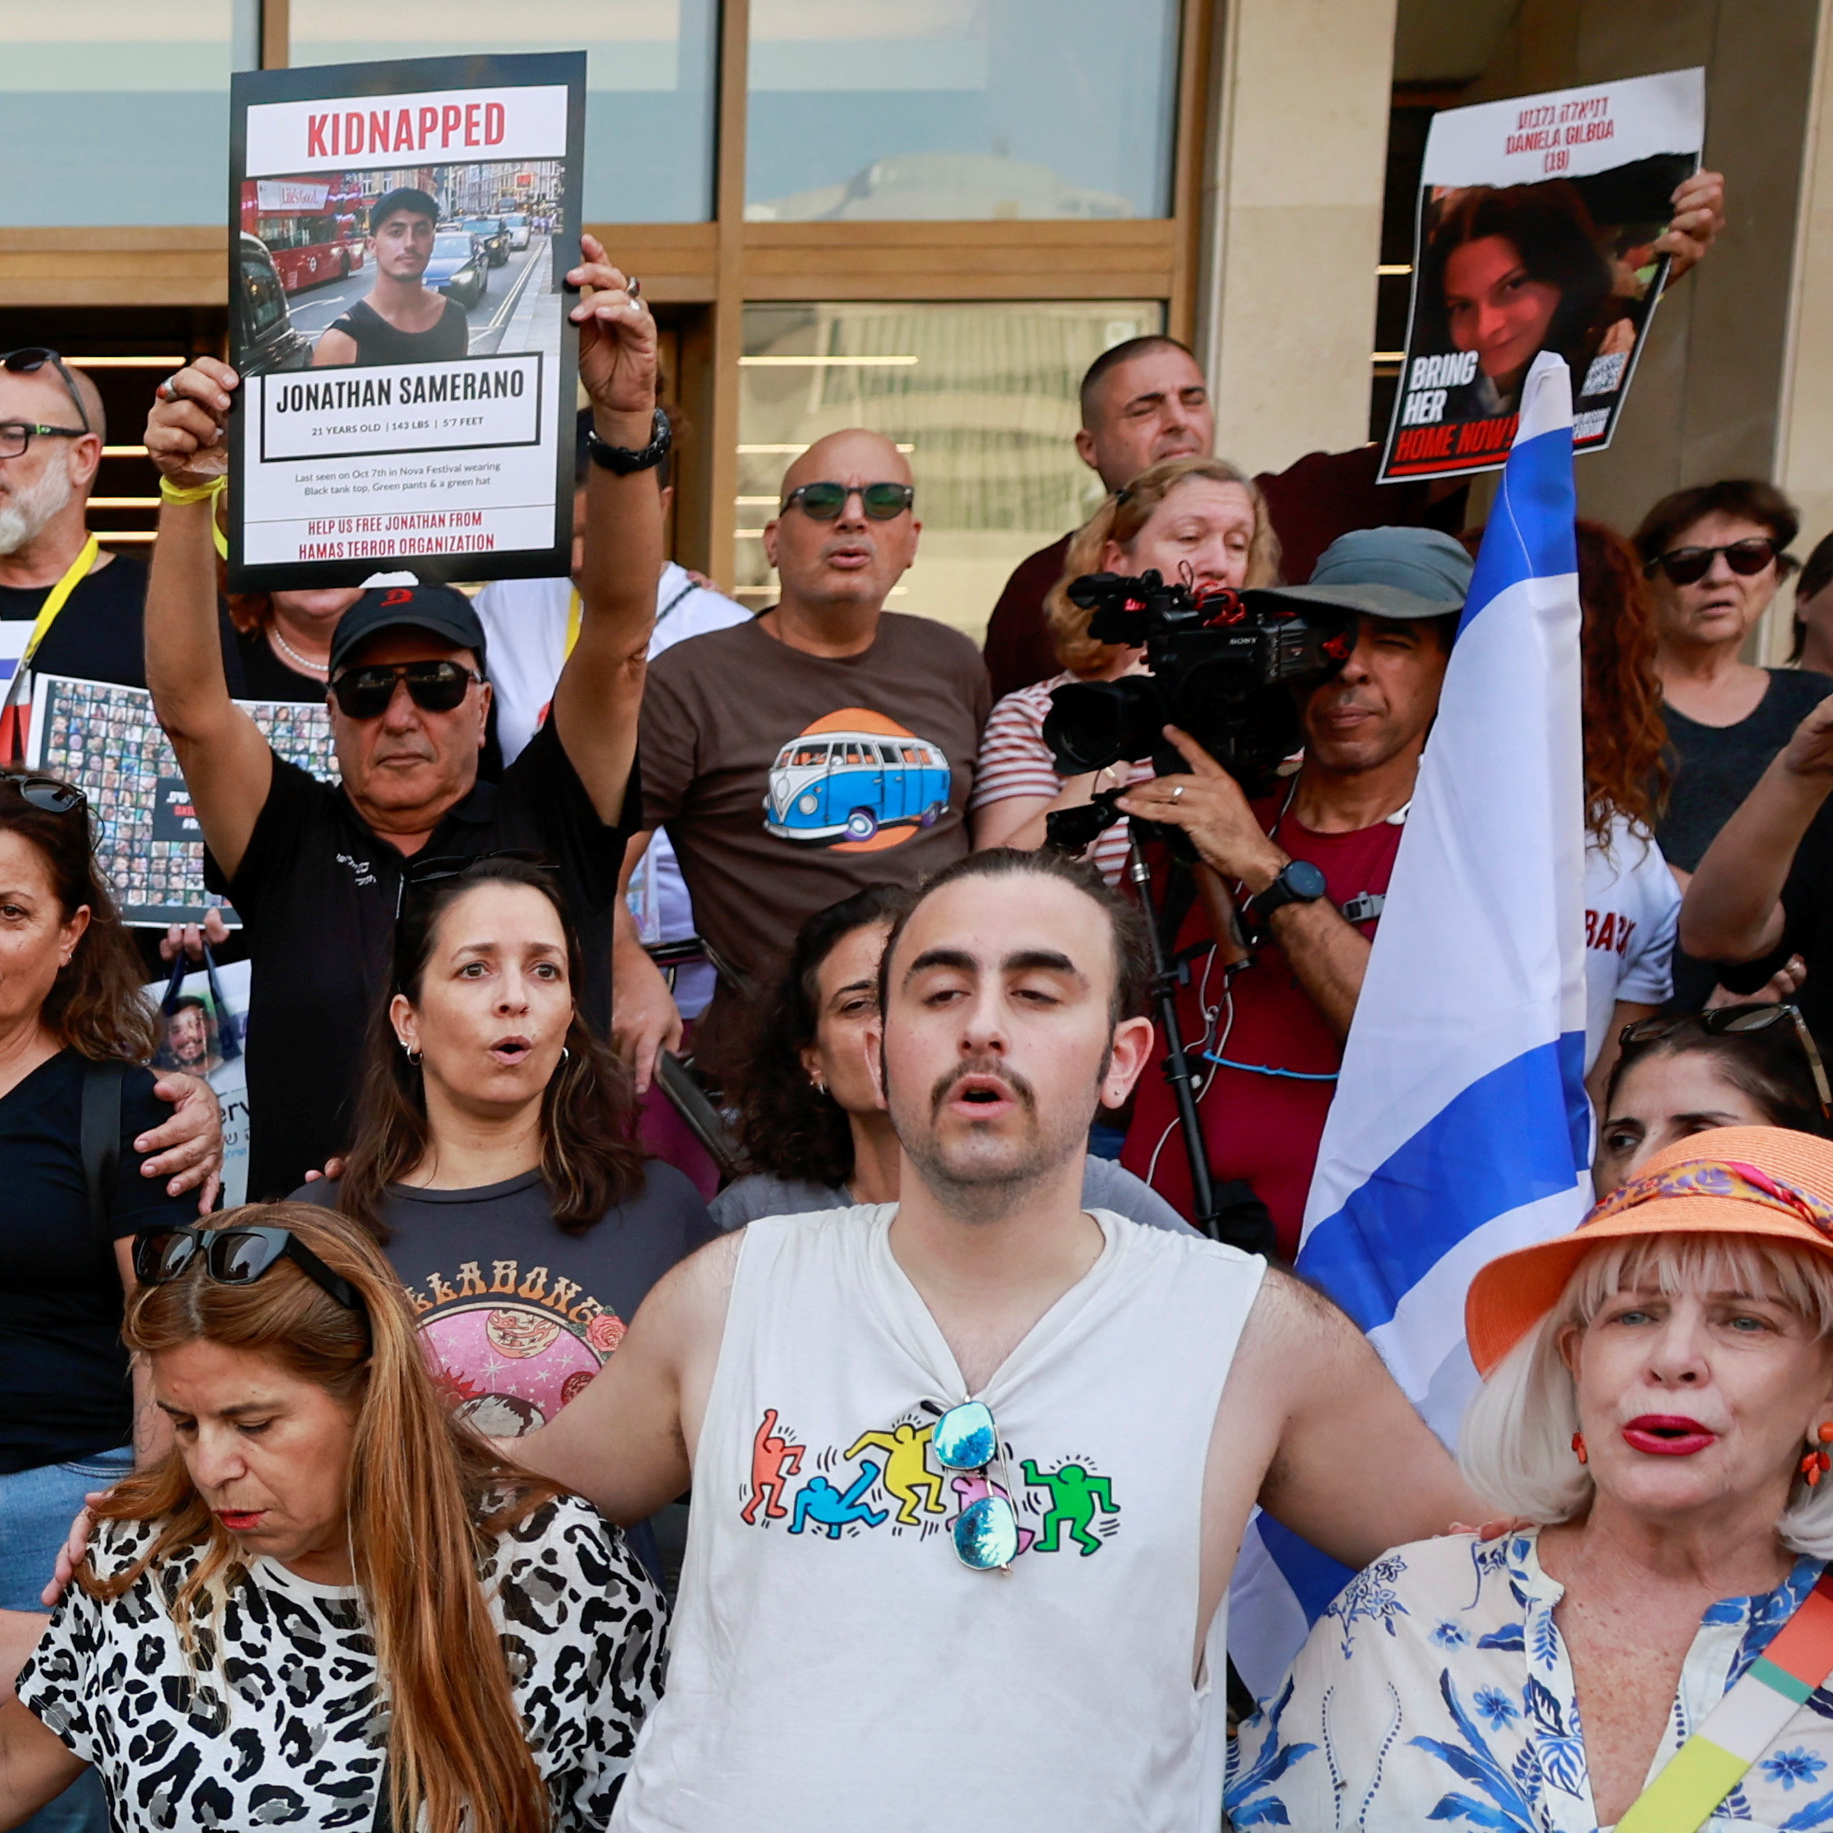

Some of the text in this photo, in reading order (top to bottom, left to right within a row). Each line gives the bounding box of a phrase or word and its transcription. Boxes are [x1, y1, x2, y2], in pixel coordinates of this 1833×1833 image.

[1560, 96, 1609, 123] דניאלה
[307, 102, 506, 158] KIDNAPPED
[1506, 119, 1614, 155] DANIELA GILBOA
[1408, 350, 1479, 391] BRING
[276, 369, 525, 413] JONATHAN SAMERANO
[1401, 389, 1448, 427] HER
[311, 427, 323, 436] 21
[326, 424, 358, 434] YEARS
[360, 423, 381, 432] OLD
[391, 420, 409, 430] 143
[411, 420, 430, 429] LBS
[460, 416, 485, 426] FEET
[1394, 412, 1520, 462] HOME NOW!
[295, 462, 501, 483] Last seen on Oct 7th in Nova Festival wearing
[304, 486, 329, 496] Black
[330, 484, 351, 495] tank
[372, 481, 400, 492] Green
[402, 481, 428, 491] pants
[447, 478, 474, 489] green
[475, 477, 491, 487] hat
[308, 511, 482, 535] HELP US FREE JONATHAN FROM
[299, 533, 494, 560] HAMAS TERROR ORGANIZATION
[1228, 636, 1258, 645] SONY
[404, 1259, 605, 1326] LLABONG
